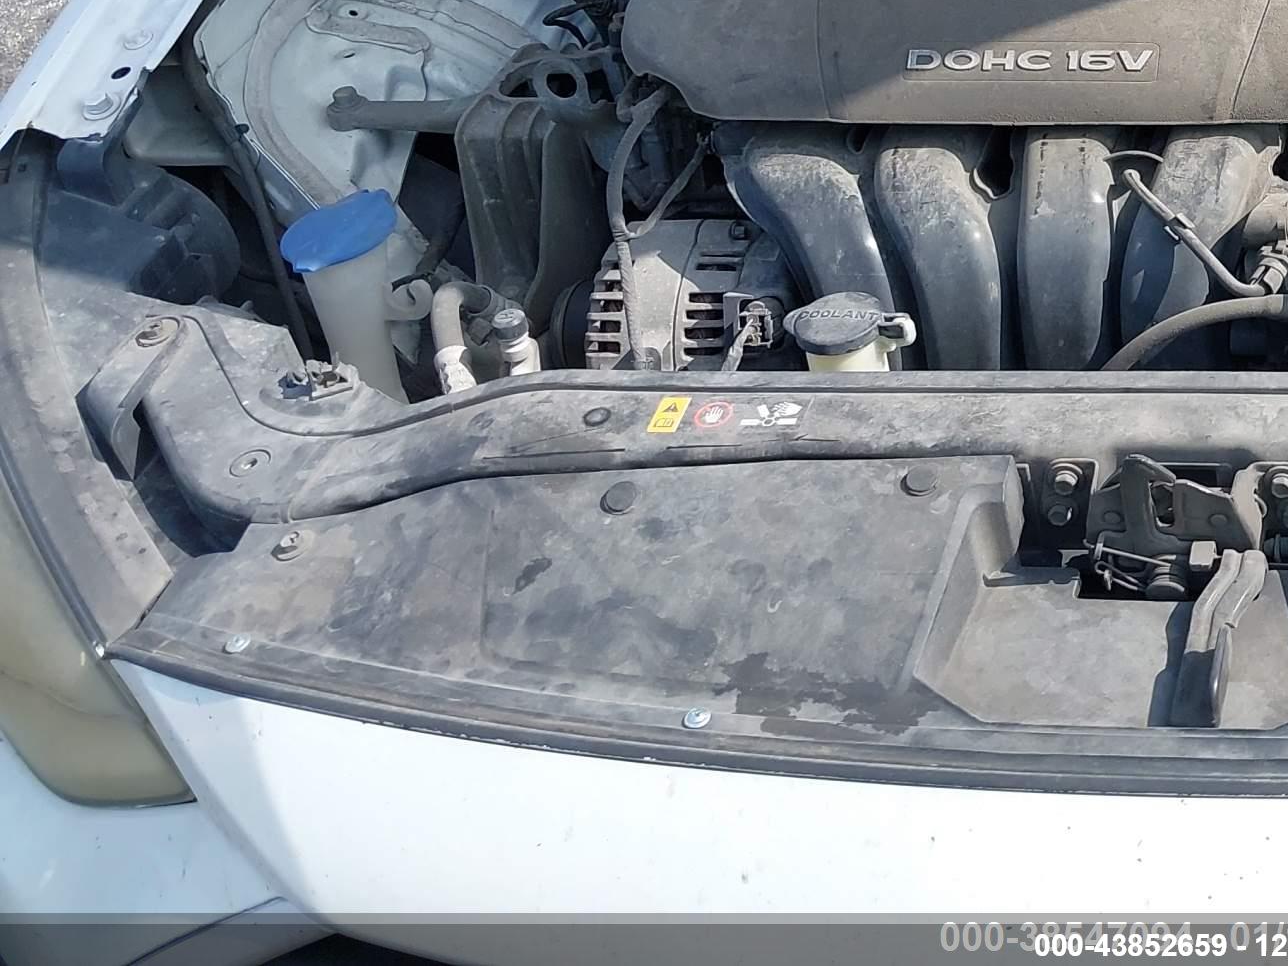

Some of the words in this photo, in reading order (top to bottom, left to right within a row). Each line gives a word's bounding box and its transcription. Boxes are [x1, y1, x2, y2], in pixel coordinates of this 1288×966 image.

[905, 49, 1052, 71] DOHC
[1065, 49, 1153, 71] 16V
[799, 309, 879, 321] COOLANT
